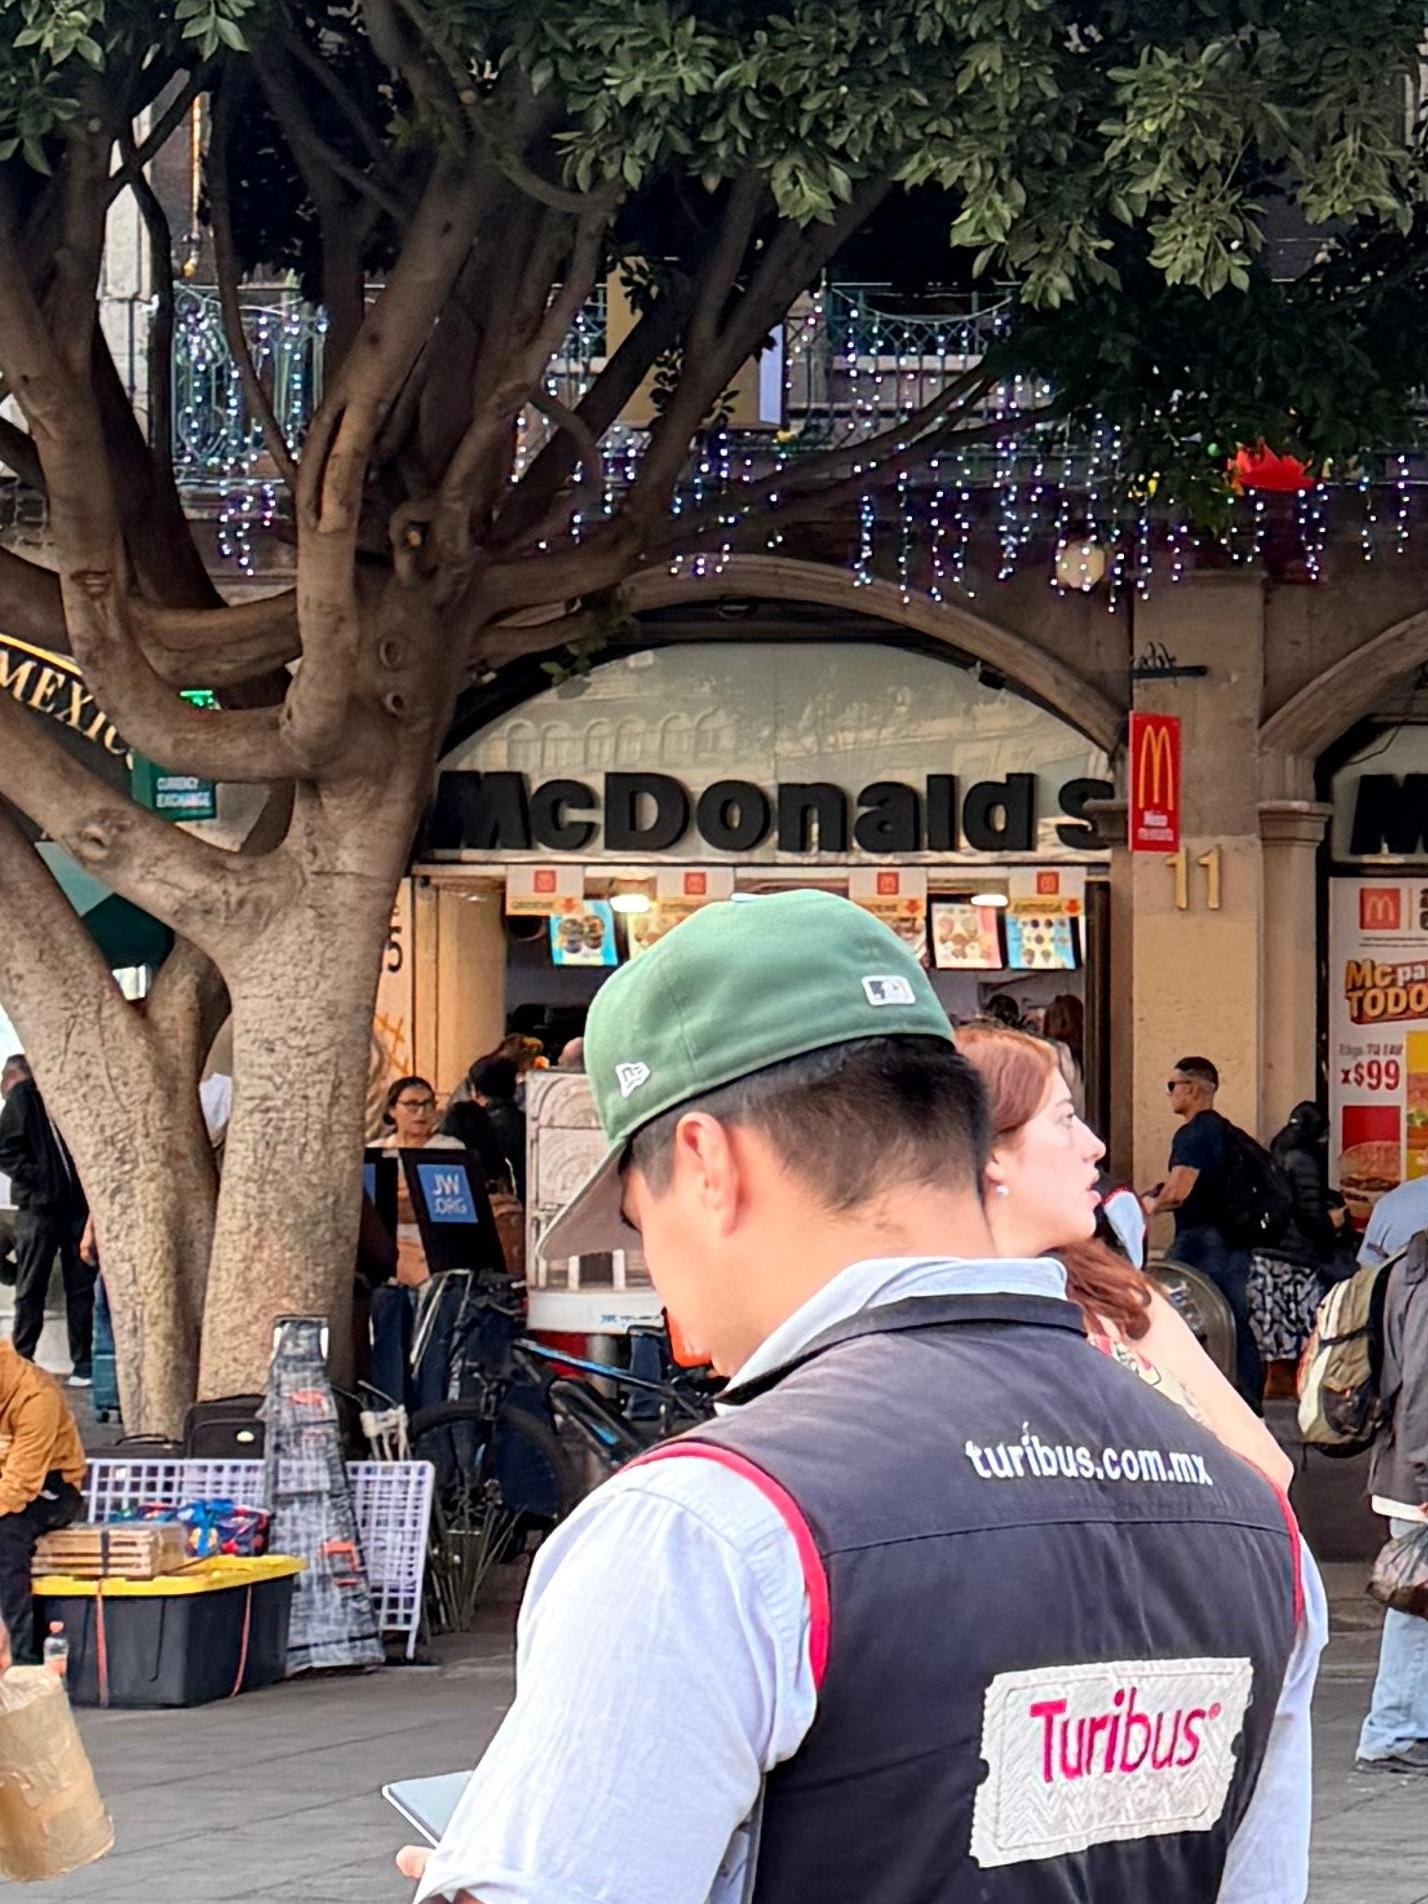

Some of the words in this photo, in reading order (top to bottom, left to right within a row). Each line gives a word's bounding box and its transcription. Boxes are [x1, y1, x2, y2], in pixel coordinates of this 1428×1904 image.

[0, 649, 134, 771] MEXIC
[1165, 845, 1220, 911] 11
[1344, 958, 1394, 991] Mc
[432, 1172, 460, 1196] JW
